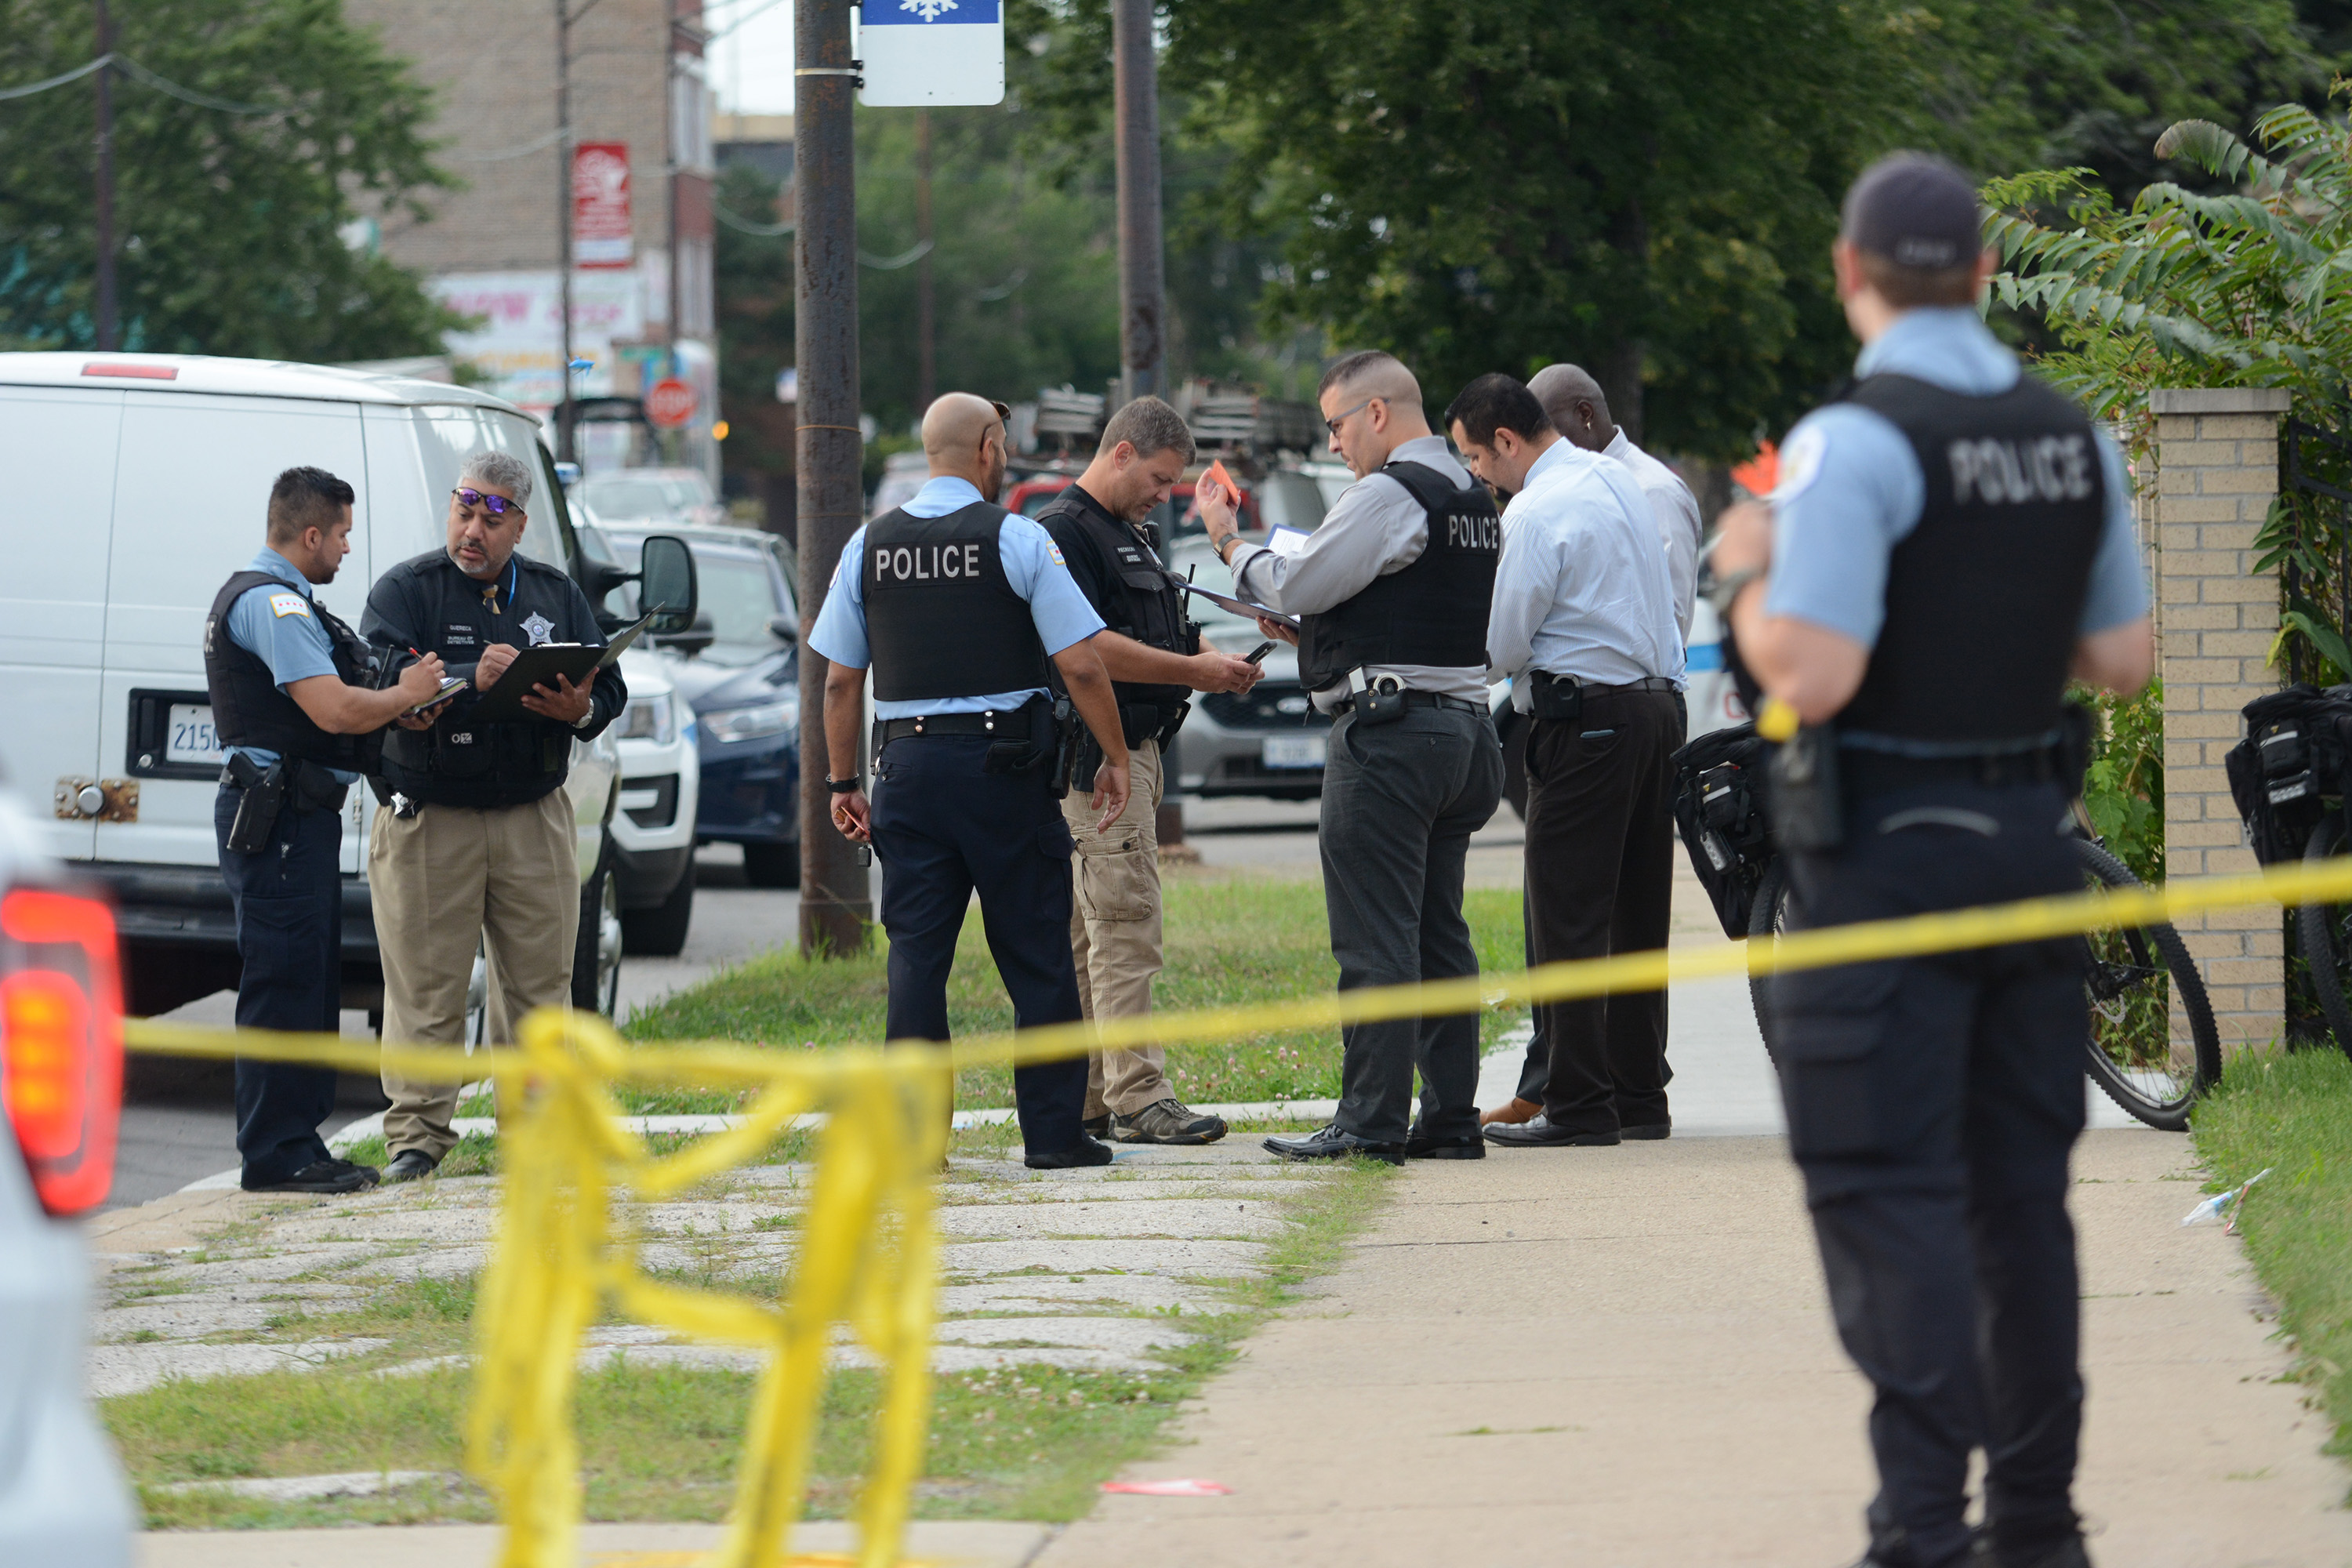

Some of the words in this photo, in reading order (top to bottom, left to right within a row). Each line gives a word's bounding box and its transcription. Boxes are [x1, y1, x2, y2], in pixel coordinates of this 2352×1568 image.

[1948, 436, 2092, 506] POLICE
[1449, 514, 1497, 550] POLICE
[877, 544, 980, 582] POLICE
